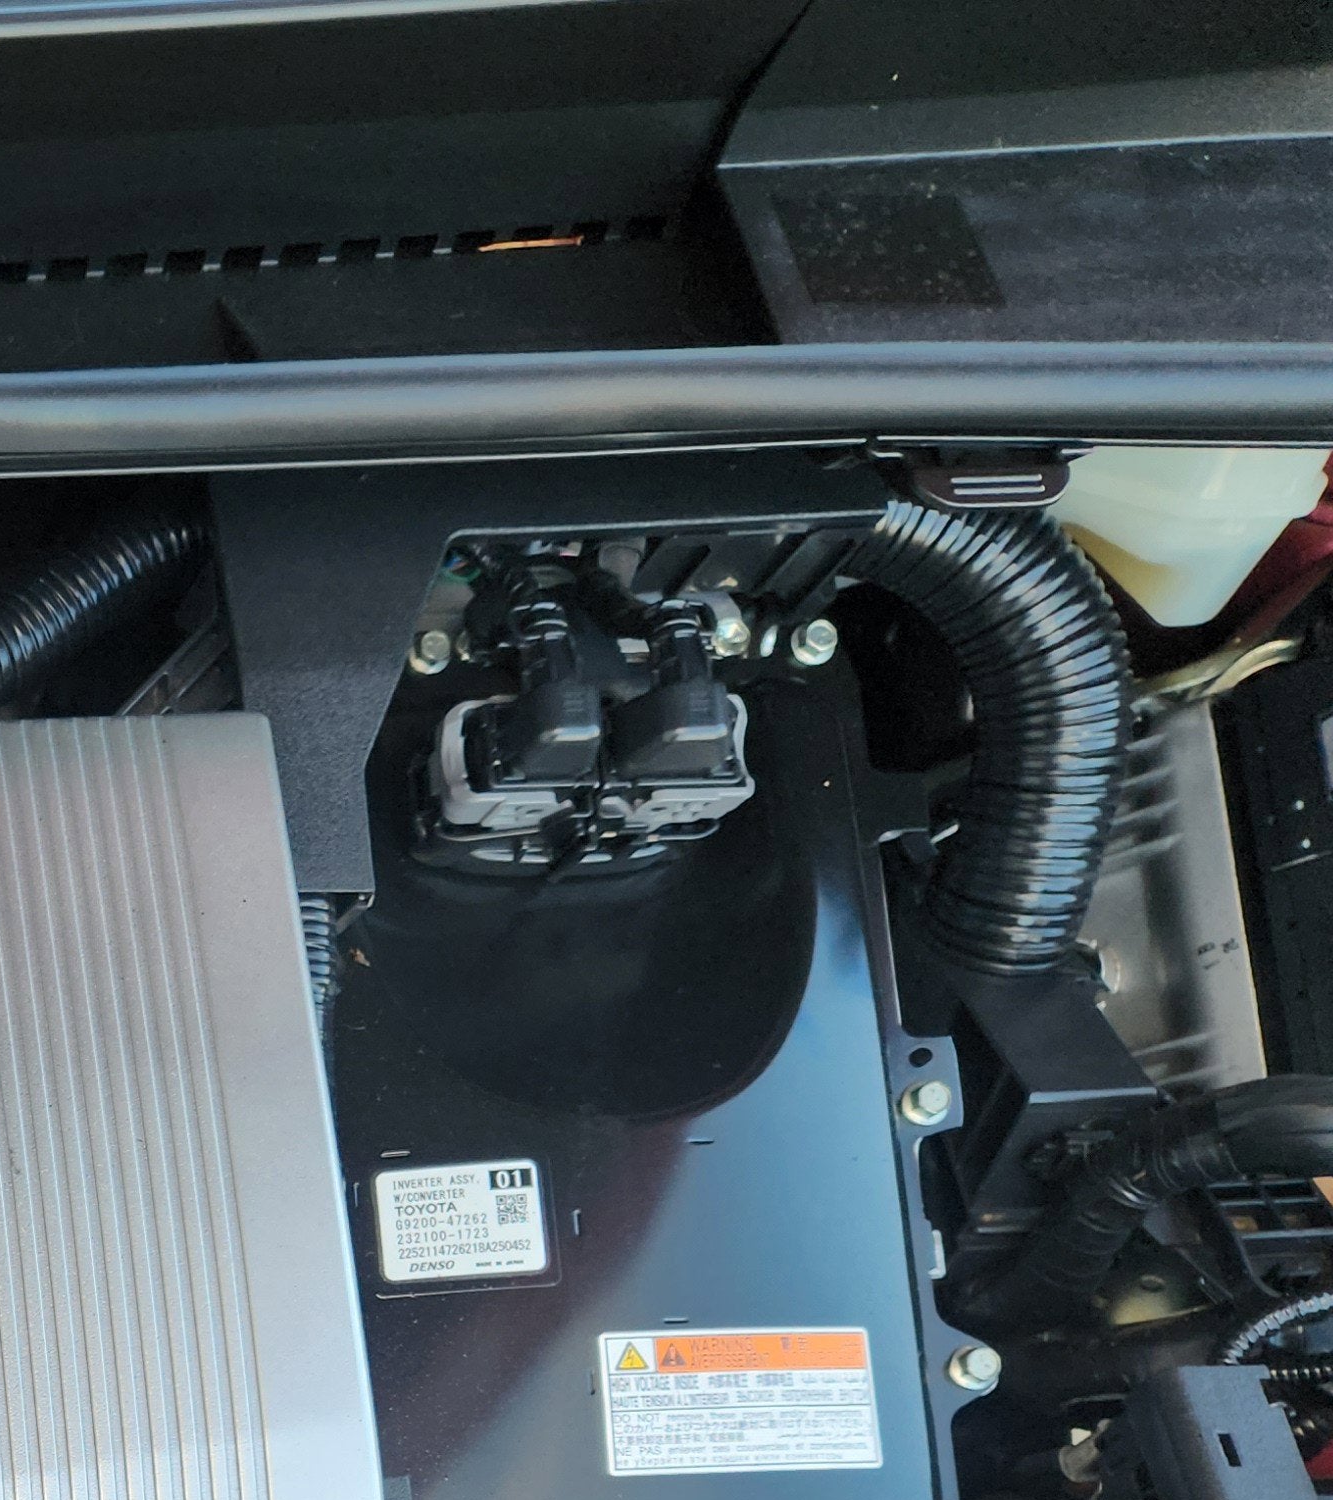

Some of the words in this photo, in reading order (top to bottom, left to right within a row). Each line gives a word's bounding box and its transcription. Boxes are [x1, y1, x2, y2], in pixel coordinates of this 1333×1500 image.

[392, 1176, 443, 1190] INVERTER
[449, 1173, 480, 1186] ASSY.
[494, 1168, 524, 1189] 01
[392, 1188, 465, 1204] W/CONVERTER
[393, 1201, 458, 1217] TOYOTA
[394, 1212, 488, 1231] G9200-47262
[396, 1226, 489, 1245] 232100-1723
[408, 1259, 455, 1273] DENSO
[612, 1414, 630, 1424] DO
[636, 1413, 660, 1423] NOT
[615, 1446, 632, 1457] NE
[639, 1445, 662, 1456] PAS
